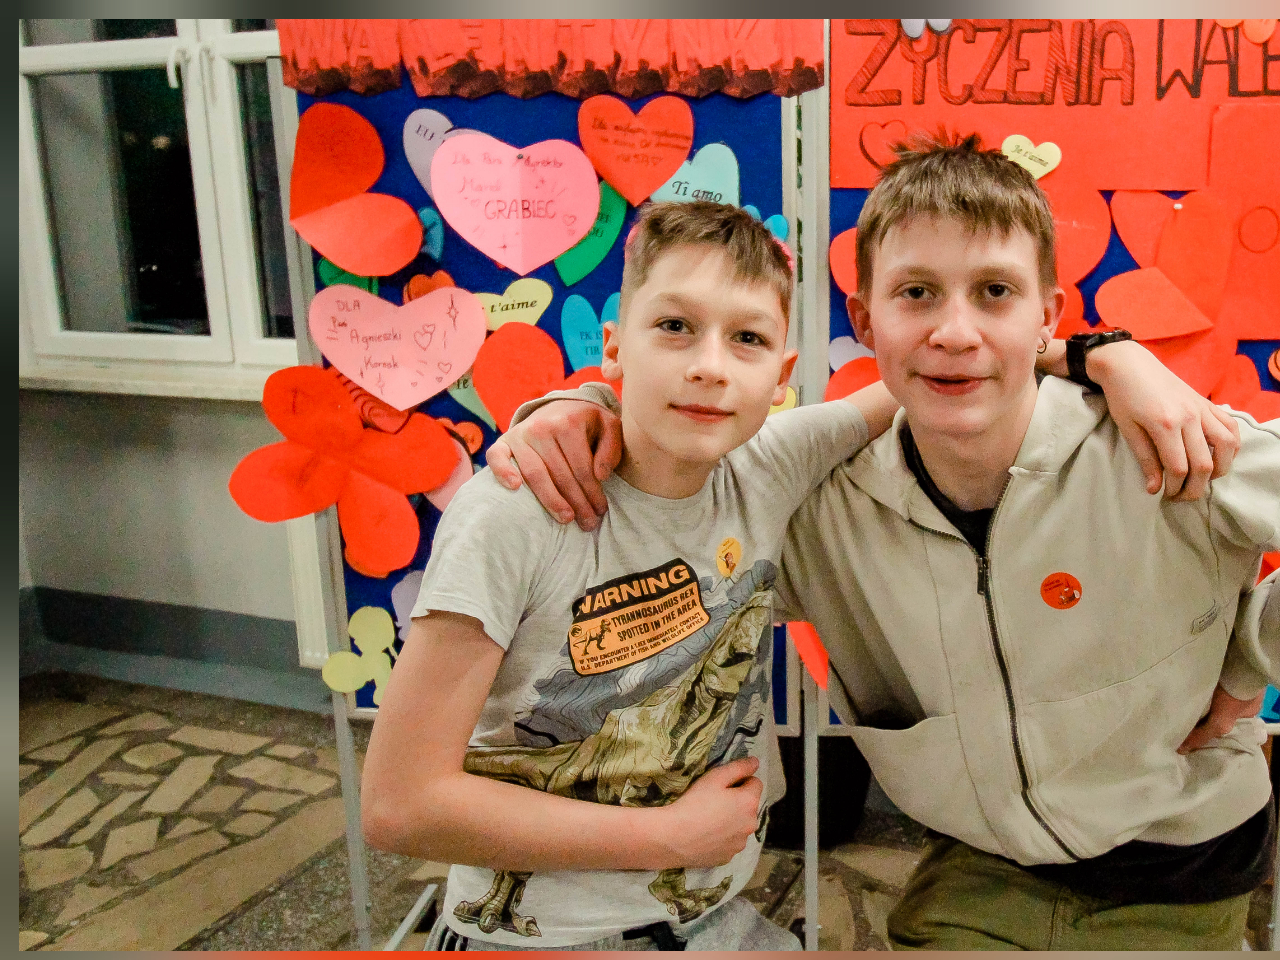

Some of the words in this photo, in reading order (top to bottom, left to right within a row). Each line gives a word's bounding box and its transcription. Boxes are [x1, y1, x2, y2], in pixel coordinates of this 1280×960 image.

[672, 180, 689, 196] Ti
[691, 189, 723, 203] amo
[485, 199, 557, 220] GRABIEC
[335, 300, 361, 312] DLA
[490, 300, 537, 313] t'aime
[611, 596, 679, 627] TYRANNOSAURUS
[679, 587, 695, 602] REX
[617, 622, 650, 641] SPOTTED
[650, 620, 661, 631] IN
[661, 611, 676, 625] THE
[677, 599, 698, 617] AREA
[594, 653, 630, 669] DEPARTMENT
[638, 645, 650, 654] FISH
[650, 641, 661, 650] AND
[661, 628, 686, 643] WILDLIFE
[686, 617, 705, 630] OFFICE
[600, 646, 630, 660] ENCOUNTER
[646, 625, 679, 644] IMMEDIATELY
[679, 612, 701, 627] CONTACT
